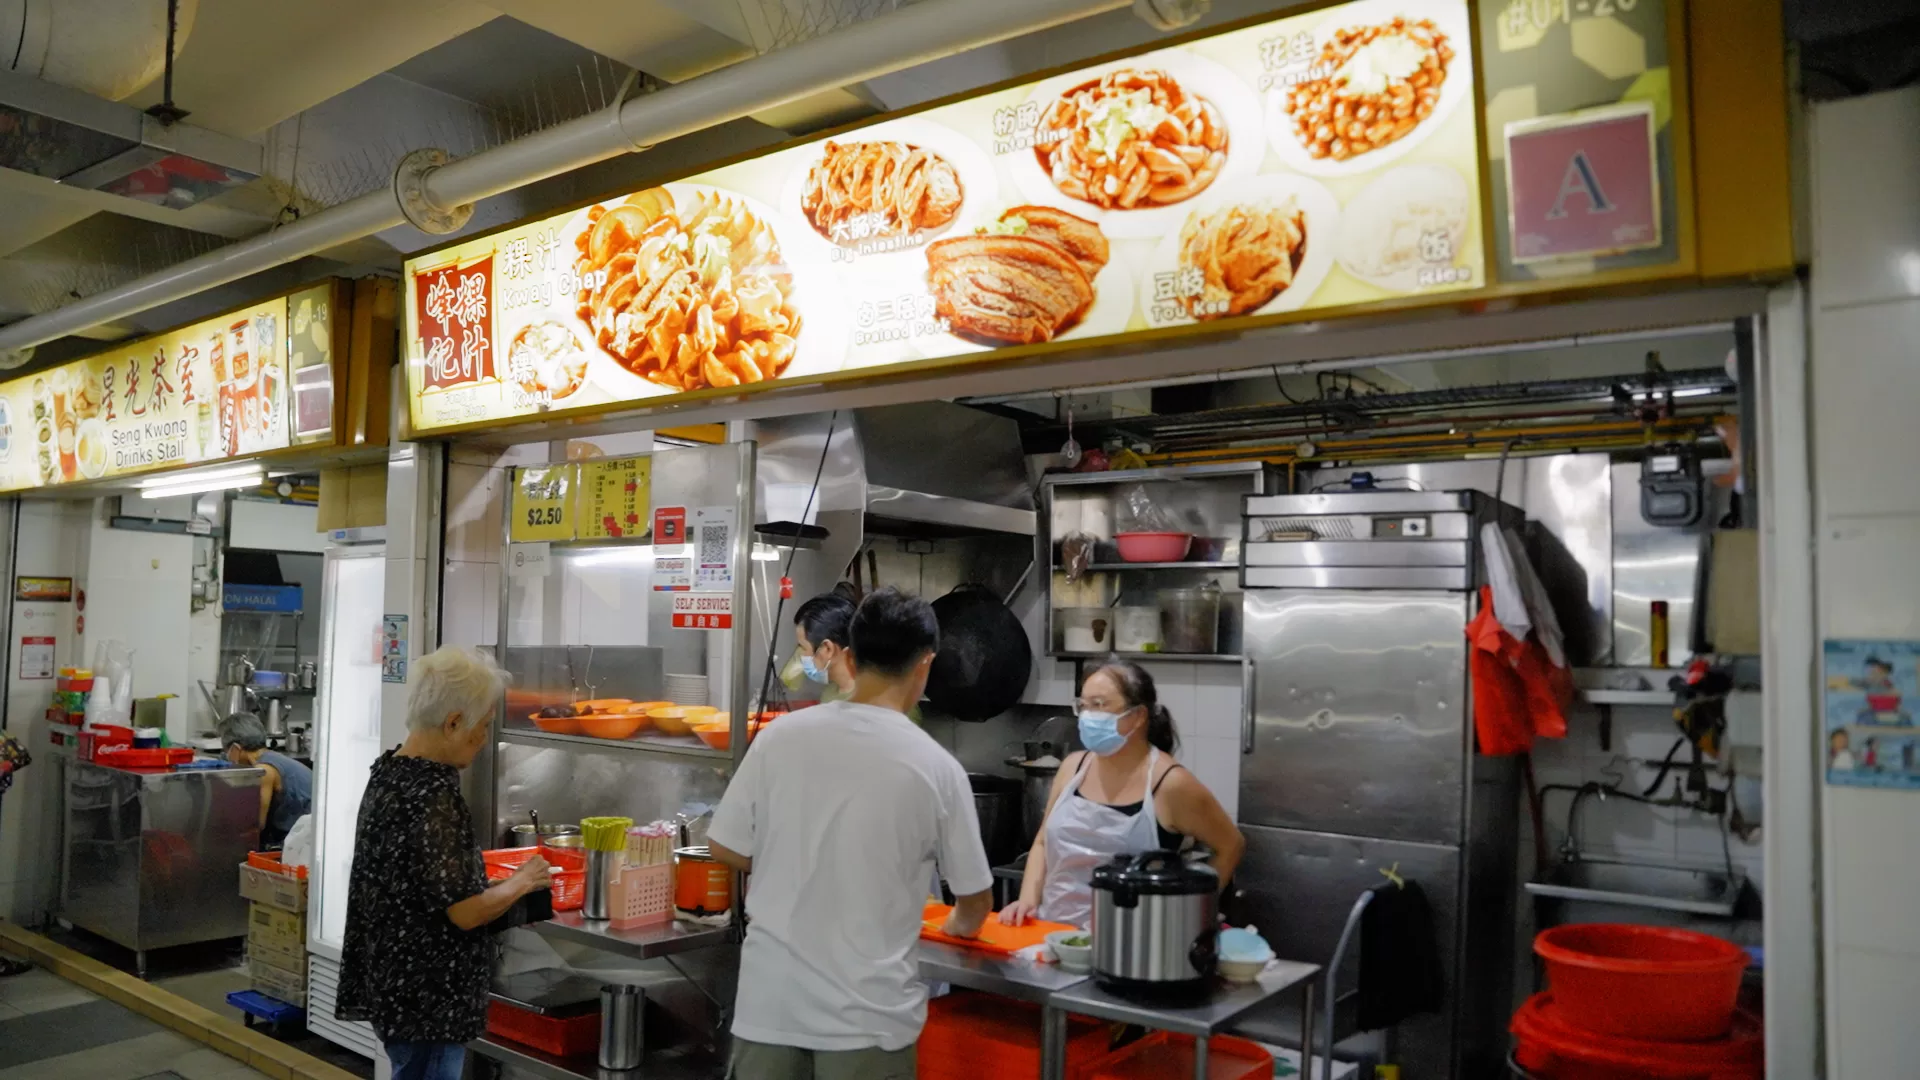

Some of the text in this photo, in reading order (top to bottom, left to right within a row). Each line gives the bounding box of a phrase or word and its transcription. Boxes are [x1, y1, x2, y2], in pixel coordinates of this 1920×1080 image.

[1545, 149, 1617, 220] A
[502, 227, 561, 280] 粿汁
[503, 268, 608, 312] Kway Chap
[511, 387, 553, 410] Kway
[111, 419, 188, 447] Seng Kwong
[115, 440, 185, 467] Drinks Stall
[527, 506, 563, 527] $2.50
[674, 597, 731, 611] SELF SERVICE
